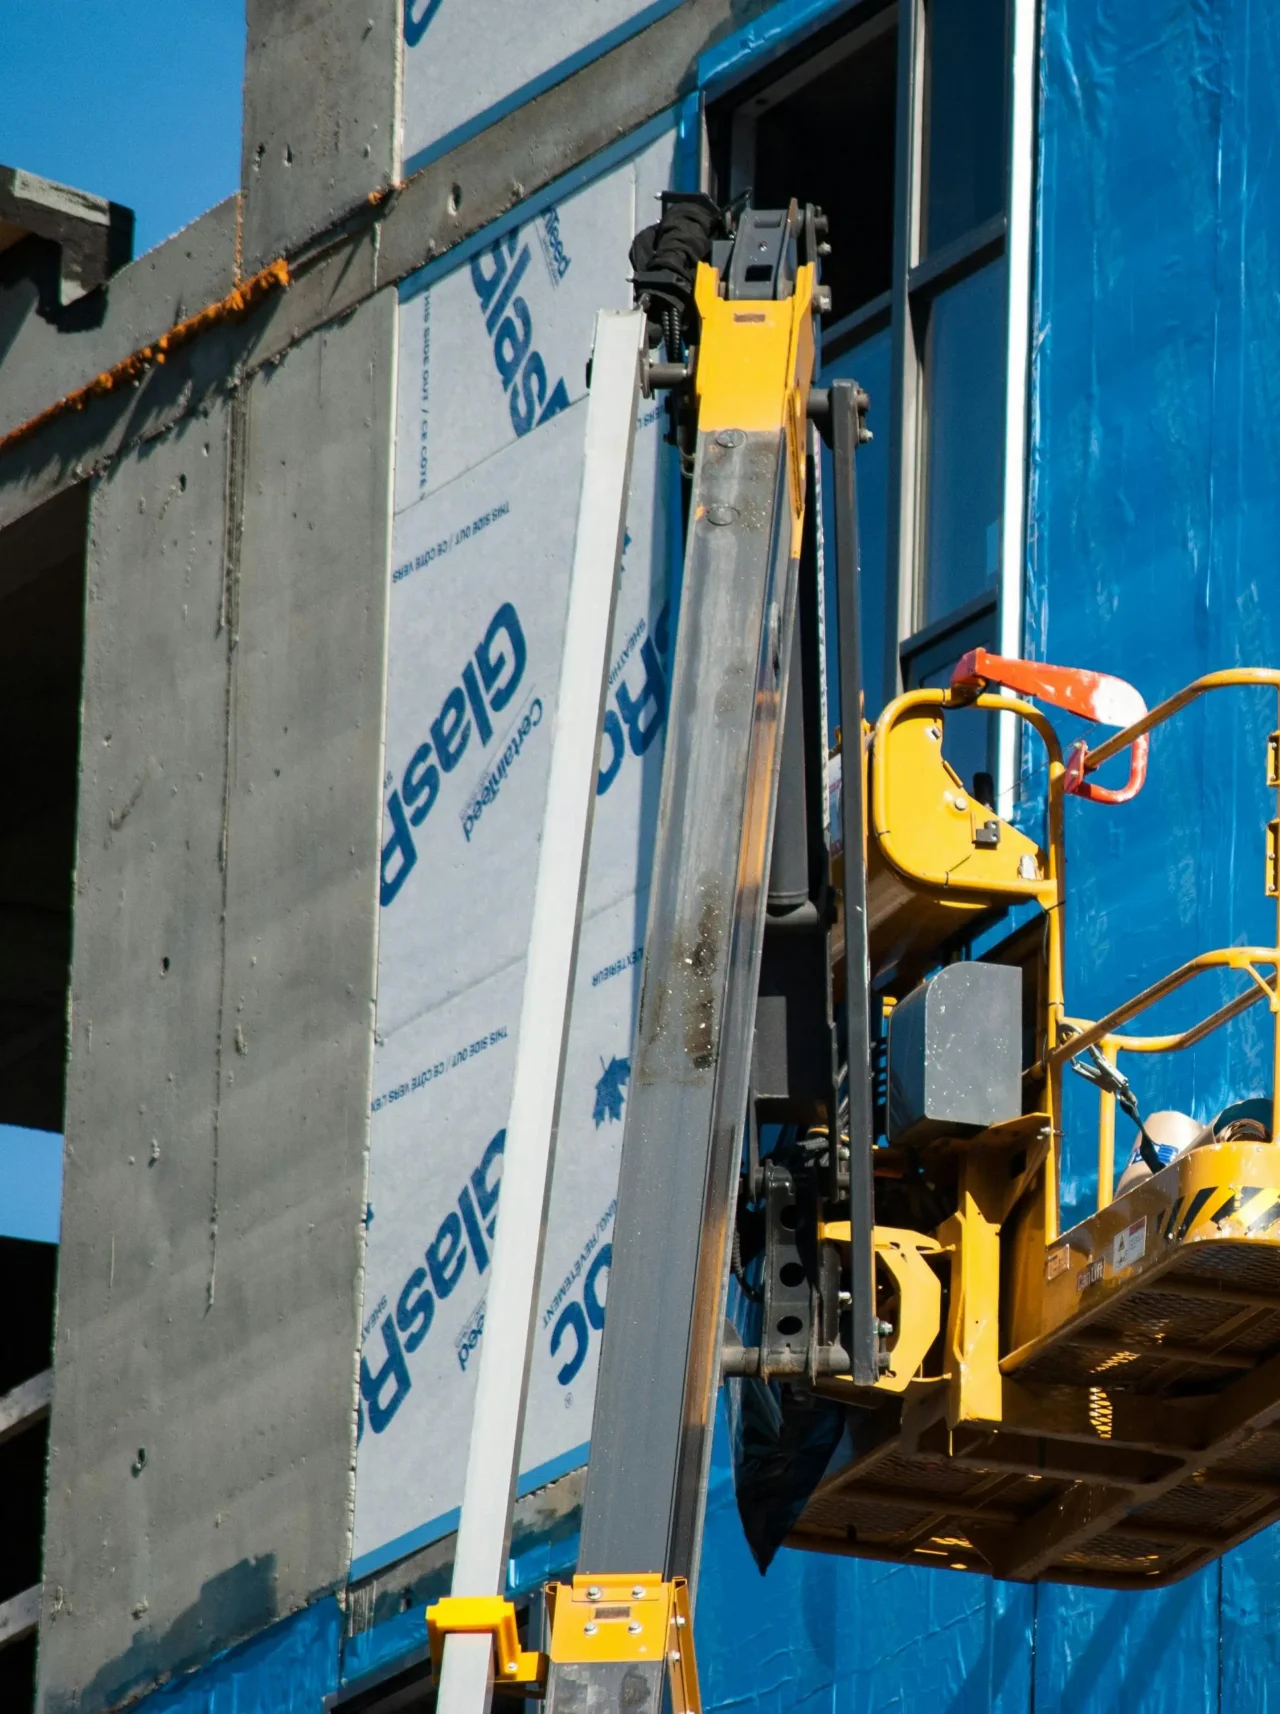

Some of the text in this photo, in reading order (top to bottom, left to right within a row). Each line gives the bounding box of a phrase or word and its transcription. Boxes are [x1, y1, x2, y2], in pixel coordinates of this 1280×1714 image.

[491, 500, 511, 522] THIS
[472, 513, 491, 536] SIDE
[455, 525, 472, 546] OUT
[463, 697, 543, 843] CertainTeed
[490, 1025, 508, 1045] THIS
[469, 1036, 488, 1057] SIDE
[452, 1047, 468, 1068] OUT
[388, 1082, 410, 1104] VERS
